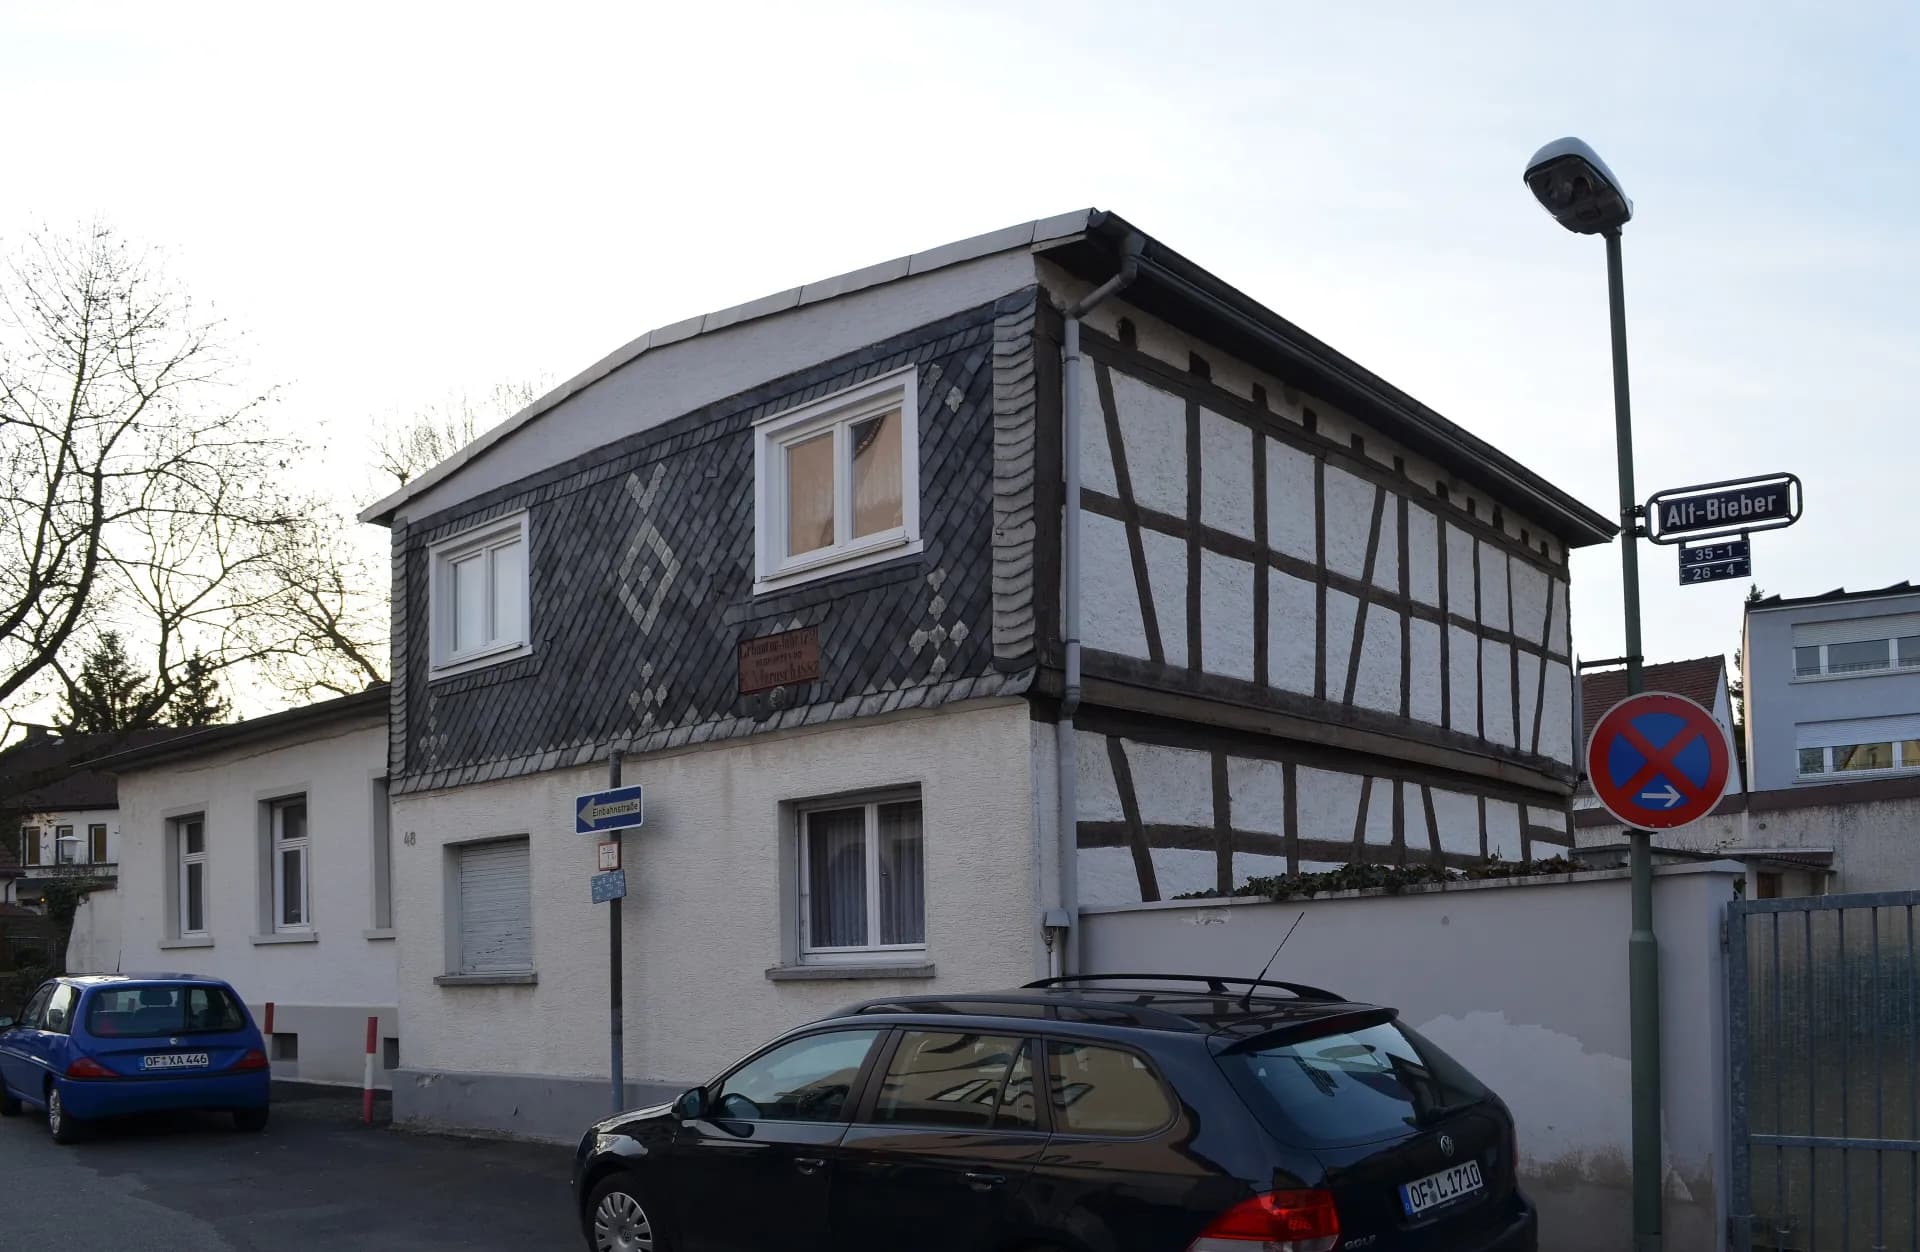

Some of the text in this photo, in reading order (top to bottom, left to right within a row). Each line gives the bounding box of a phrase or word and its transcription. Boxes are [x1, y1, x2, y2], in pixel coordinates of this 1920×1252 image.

[1667, 494, 1776, 527] Alt-Bieber
[592, 802, 638, 817] Einbahnstraße
[404, 831, 416, 847] 48
[168, 1055, 184, 1065] XA
[186, 1054, 207, 1065] 446
[1410, 1164, 1481, 1208] OF L 1710
